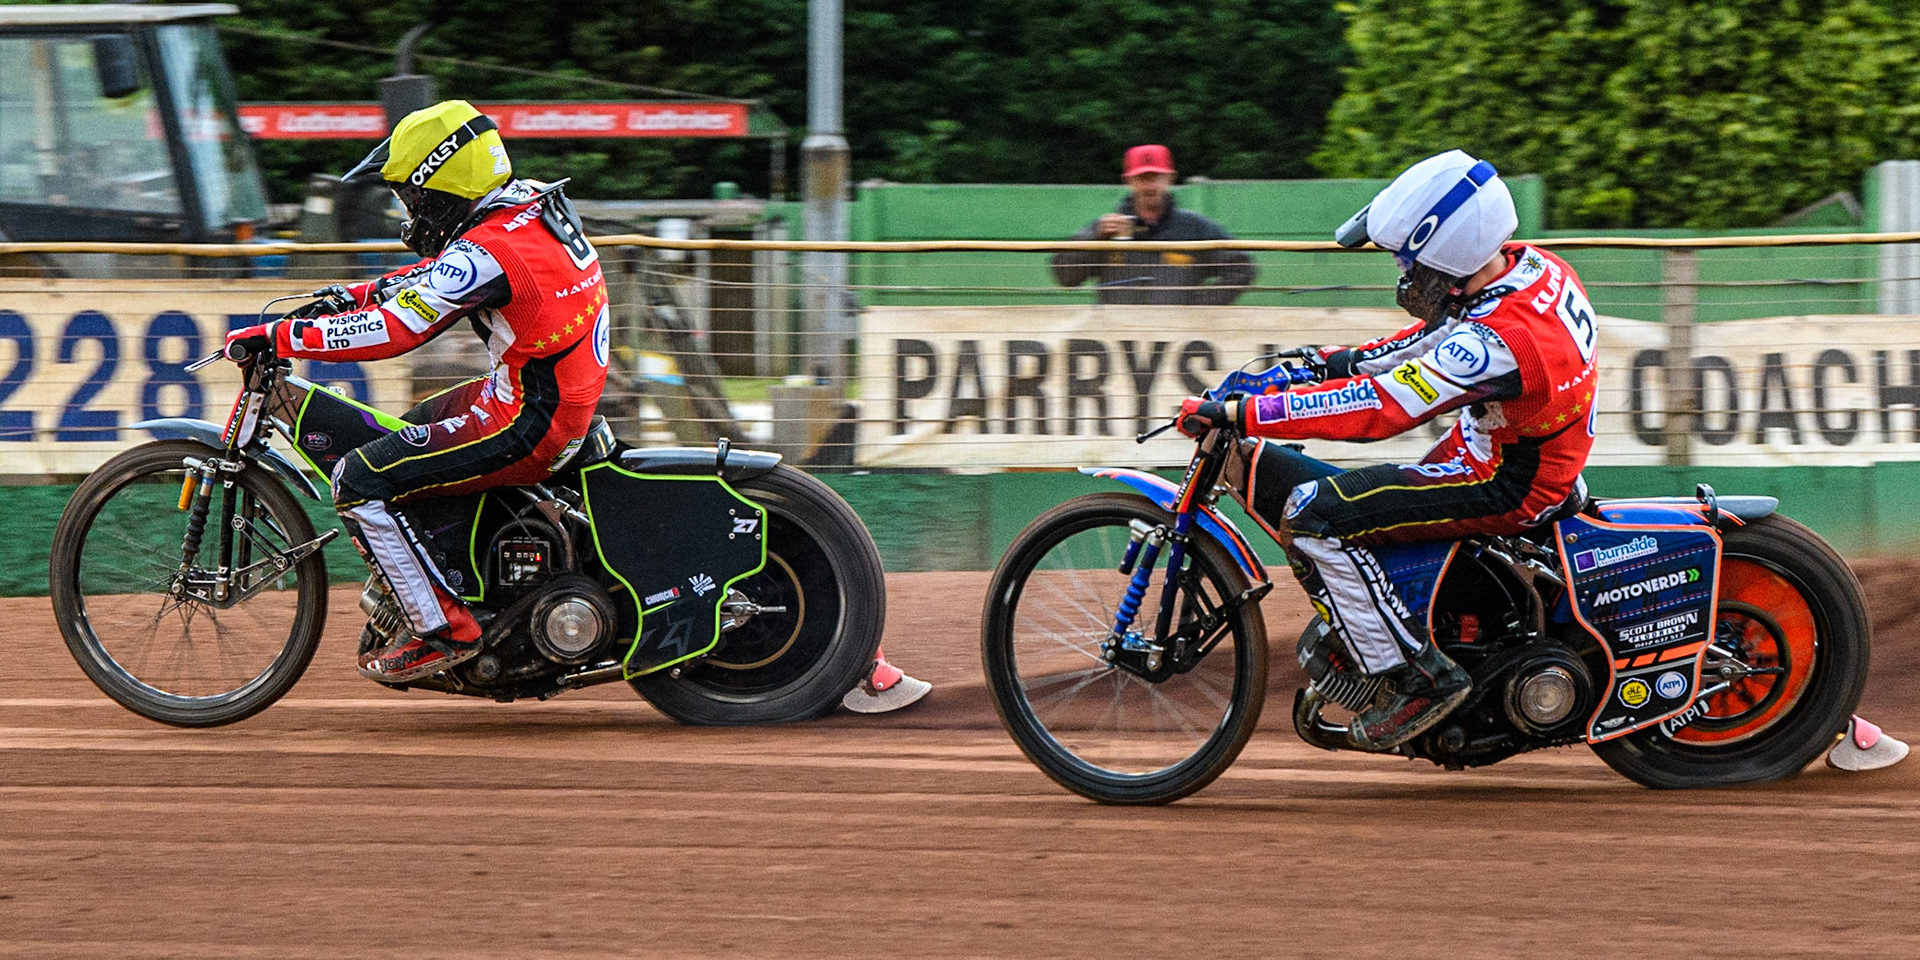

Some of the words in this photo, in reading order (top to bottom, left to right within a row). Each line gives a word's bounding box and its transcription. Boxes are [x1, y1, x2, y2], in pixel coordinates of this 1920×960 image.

[411, 134, 460, 186] OAKLEY
[434, 262, 467, 282] ATPI
[327, 320, 384, 338] PLASTICS
[328, 312, 368, 325] VISION
[1565, 290, 1594, 348] 5
[328, 339, 350, 350] LTD
[1442, 341, 1479, 369] ATPI
[892, 337, 1217, 436] PARRYS
[1290, 379, 1378, 411] burnside
[1597, 536, 1657, 561] burnside
[1593, 570, 1688, 607] MOTOVERDE
[1619, 623, 1654, 642] SCOTT
[1657, 612, 1698, 629] BROWN
[1662, 680, 1681, 690] ATPI
[1670, 705, 1700, 731] ATPI
